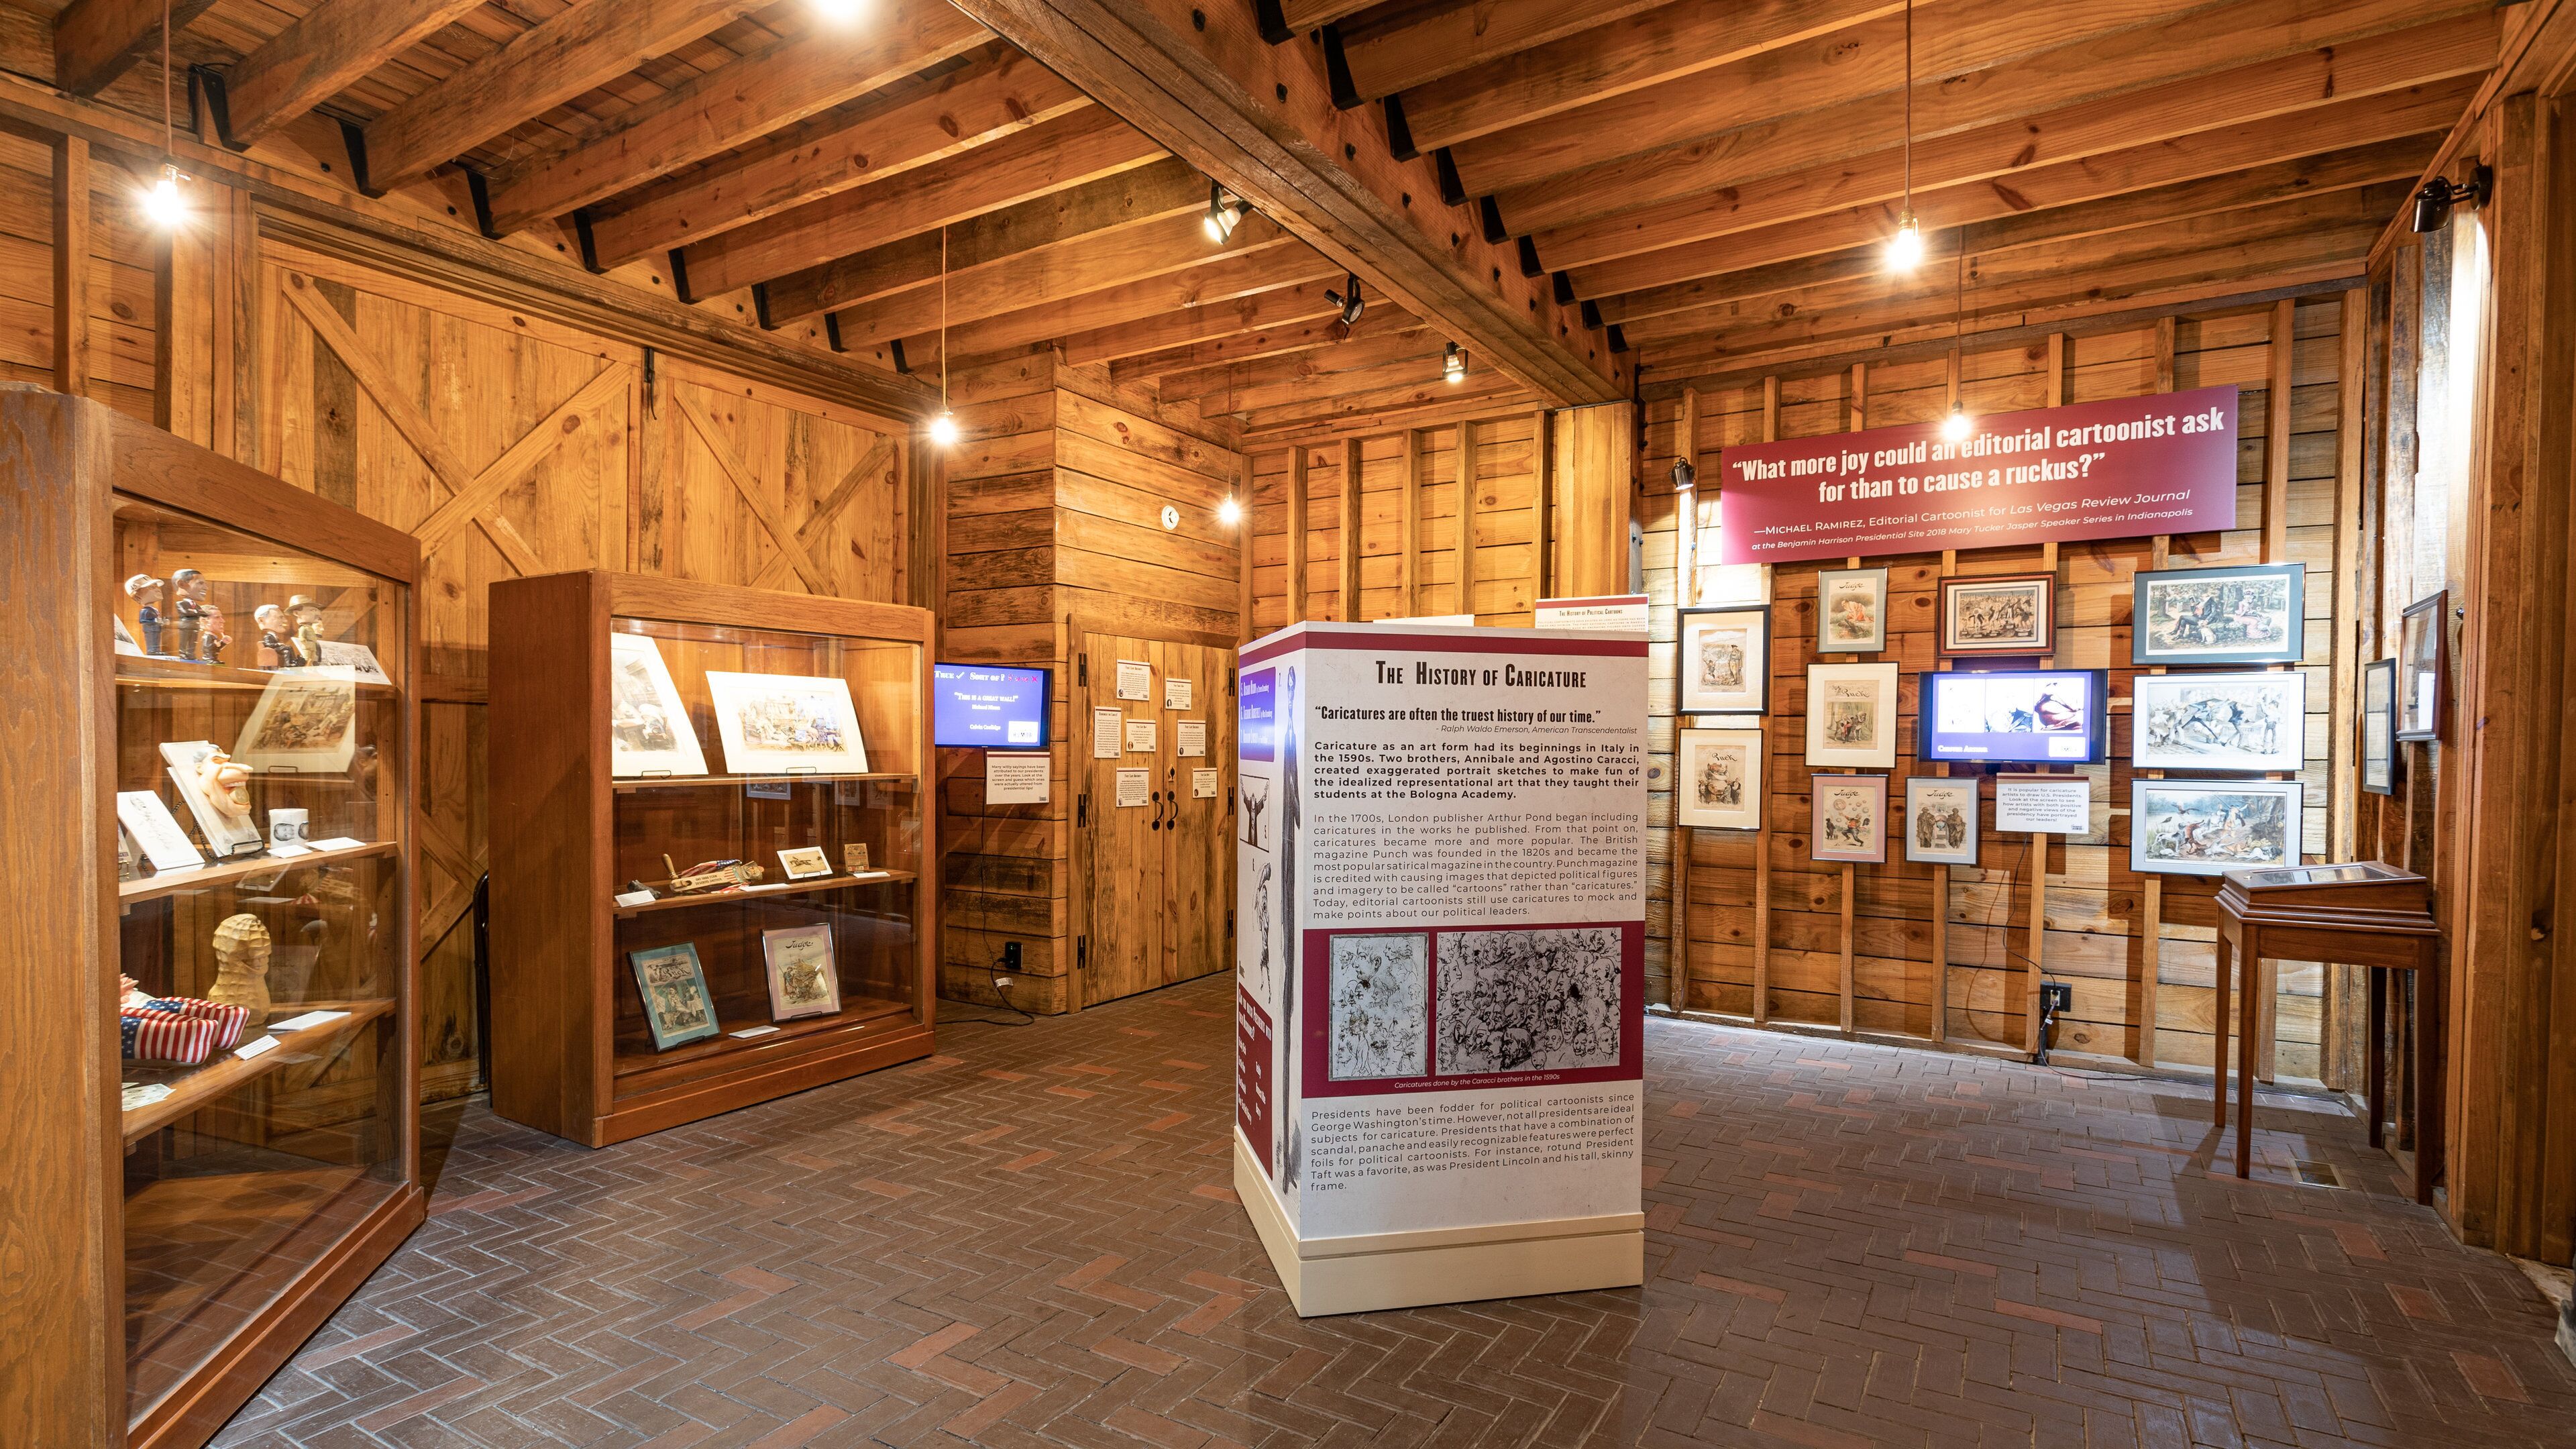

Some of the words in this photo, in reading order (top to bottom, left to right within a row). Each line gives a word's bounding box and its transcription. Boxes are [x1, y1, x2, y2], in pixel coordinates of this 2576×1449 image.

[1732, 460, 1786, 481] “What
[1790, 455, 1836, 476] more
[1841, 450, 1869, 476] joy
[1874, 441, 1926, 467] could
[1931, 442, 1955, 462] an
[1960, 427, 2050, 458] editorial
[2057, 415, 2175, 448] cartoonist
[2182, 407, 2224, 434] ask
[1819, 481, 1845, 502] for
[1849, 478, 1892, 499] than
[1898, 476, 1918, 495] to
[1924, 471, 1982, 492] cause
[1988, 469, 2000, 486] a
[2006, 452, 2105, 484] ruckus?”
[1869, 514, 1917, 527] Editorial
[1921, 508, 1985, 521] Cartoonist
[1988, 506, 2006, 516] for
[2010, 504, 2032, 515] Las
[2037, 502, 2077, 513] Vegas
[2081, 496, 2131, 508] Review
[2133, 489, 2190, 504] Journal
[1777, 539, 1816, 548] Benjamin
[1818, 537, 1854, 545] Harrison
[1856, 531, 1907, 542] Presidential
[1926, 528, 1947, 536] 2018
[2006, 522, 2039, 530] Jasper
[2041, 518, 2081, 528] Speaker
[2082, 515, 2112, 524] Series
[2127, 508, 2193, 521] Indianapolis
[1839, 581, 1865, 591] Judge
[1376, 661, 1403, 684] THE
[1416, 661, 1477, 686] HISTORY
[1505, 663, 1586, 688] CARICATURE
[1841, 688, 1870, 698] Puck
[1315, 706, 1385, 720] “Caricatures
[1389, 710, 1405, 720] are
[1409, 707, 1437, 720] often
[1440, 708, 1458, 721] the
[1461, 710, 1494, 722] truest
[1497, 708, 1534, 725] history
[1537, 710, 1547, 722] of
[1550, 712, 1567, 722] our
[1569, 710, 1601, 723] time.”
[1441, 724, 1464, 733] Ralph
[1494, 725, 1530, 734] Emerson,
[1315, 741, 1377, 750] Caricature
[1442, 743, 1468, 751] form
[1474, 743, 1495, 751] had
[1501, 743, 1513, 751] its
[1519, 743, 1580, 754] beginnings
[1586, 743, 1595, 752] in
[1601, 744, 1625, 754] Italy
[1630, 744, 1639, 752] in
[1314, 753, 1334, 762] the
[1339, 754, 1374, 762] 1590s.
[1379, 754, 1402, 762] Two
[1407, 754, 1460, 764] brothers,
[1464, 754, 1515, 763] Annibale
[1519, 755, 1539, 763] and
[1544, 755, 1593, 765] Agostino
[1597, 755, 1639, 765] Caracci,
[1712, 752, 1737, 761] Puck
[1314, 765, 1359, 774] created
[1366, 766, 1440, 776] exaggerated
[1447, 766, 1491, 776] portrait
[1497, 766, 1546, 775] sketches
[1570, 767, 1599, 775] make
[1605, 767, 1622, 775] fun
[1629, 767, 1640, 775] of
[1313, 777, 1334, 786] the
[1339, 777, 1391, 786] idealized
[1397, 777, 1493, 788] representational
[1517, 778, 1540, 787] that
[1544, 778, 1569, 788] they
[1573, 778, 1609, 788] taught
[1613, 777, 1639, 786] their
[1314, 790, 1366, 798] students
[1386, 790, 1405, 798] the
[1410, 790, 1457, 800] Bologna
[1461, 790, 1516, 800] Academy.
[1834, 789, 1860, 799] Judge
[1927, 790, 1953, 800] Judge
[663, 968, 692, 977] Puck
